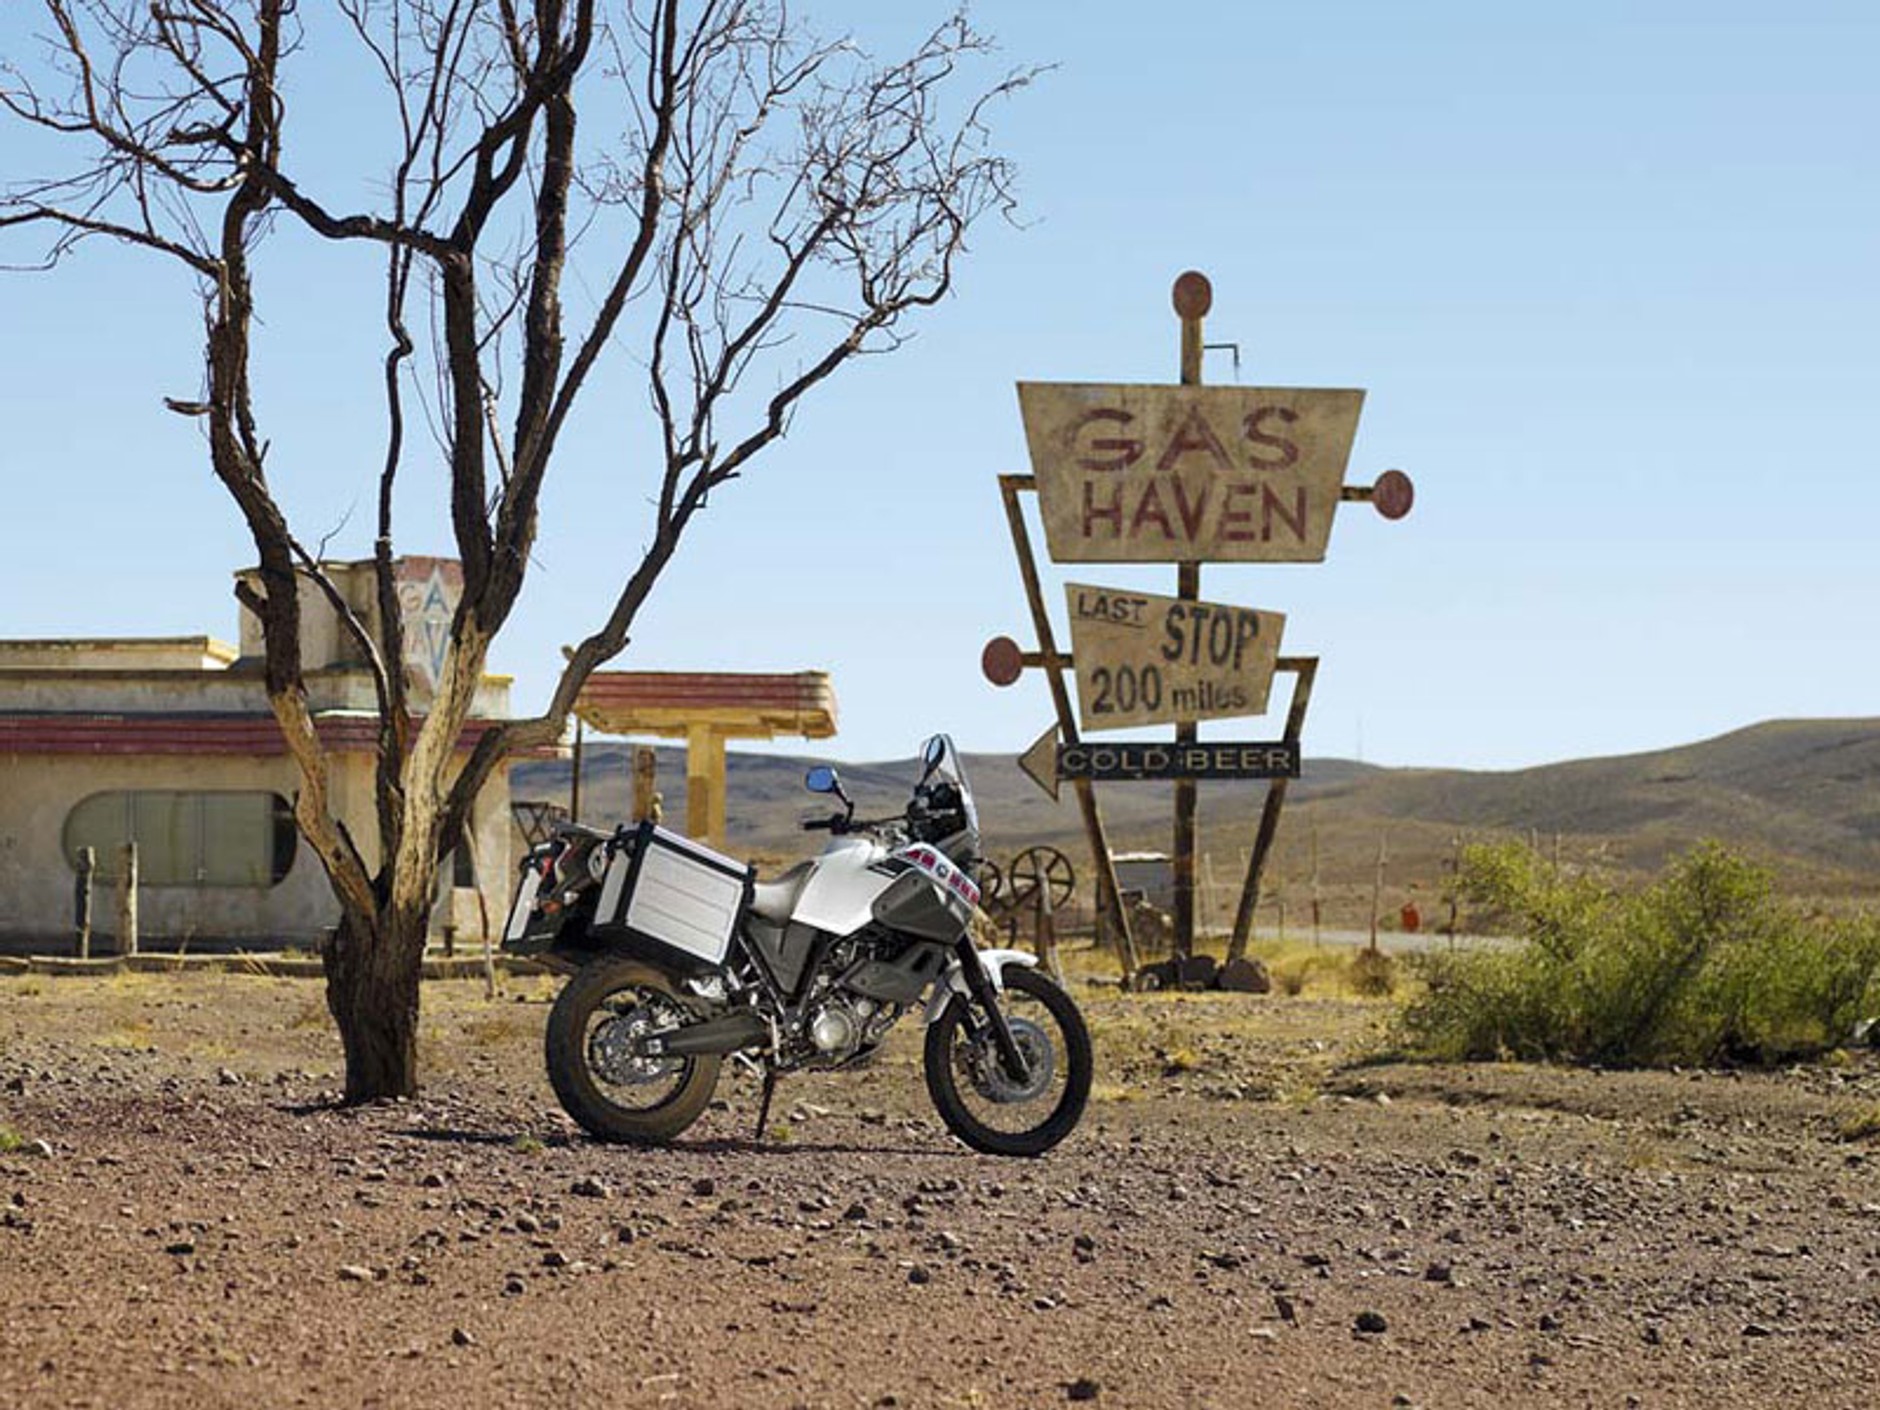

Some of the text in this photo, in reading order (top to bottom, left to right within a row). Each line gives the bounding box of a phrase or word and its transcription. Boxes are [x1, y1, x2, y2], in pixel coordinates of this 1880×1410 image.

[1064, 404, 1299, 471] GAS
[1082, 471, 1306, 542] HAVEN
[1078, 593, 1259, 671] LAST STOP
[1091, 662, 1249, 714] 200 miles
[1061, 749, 1291, 771] COLD BEER
